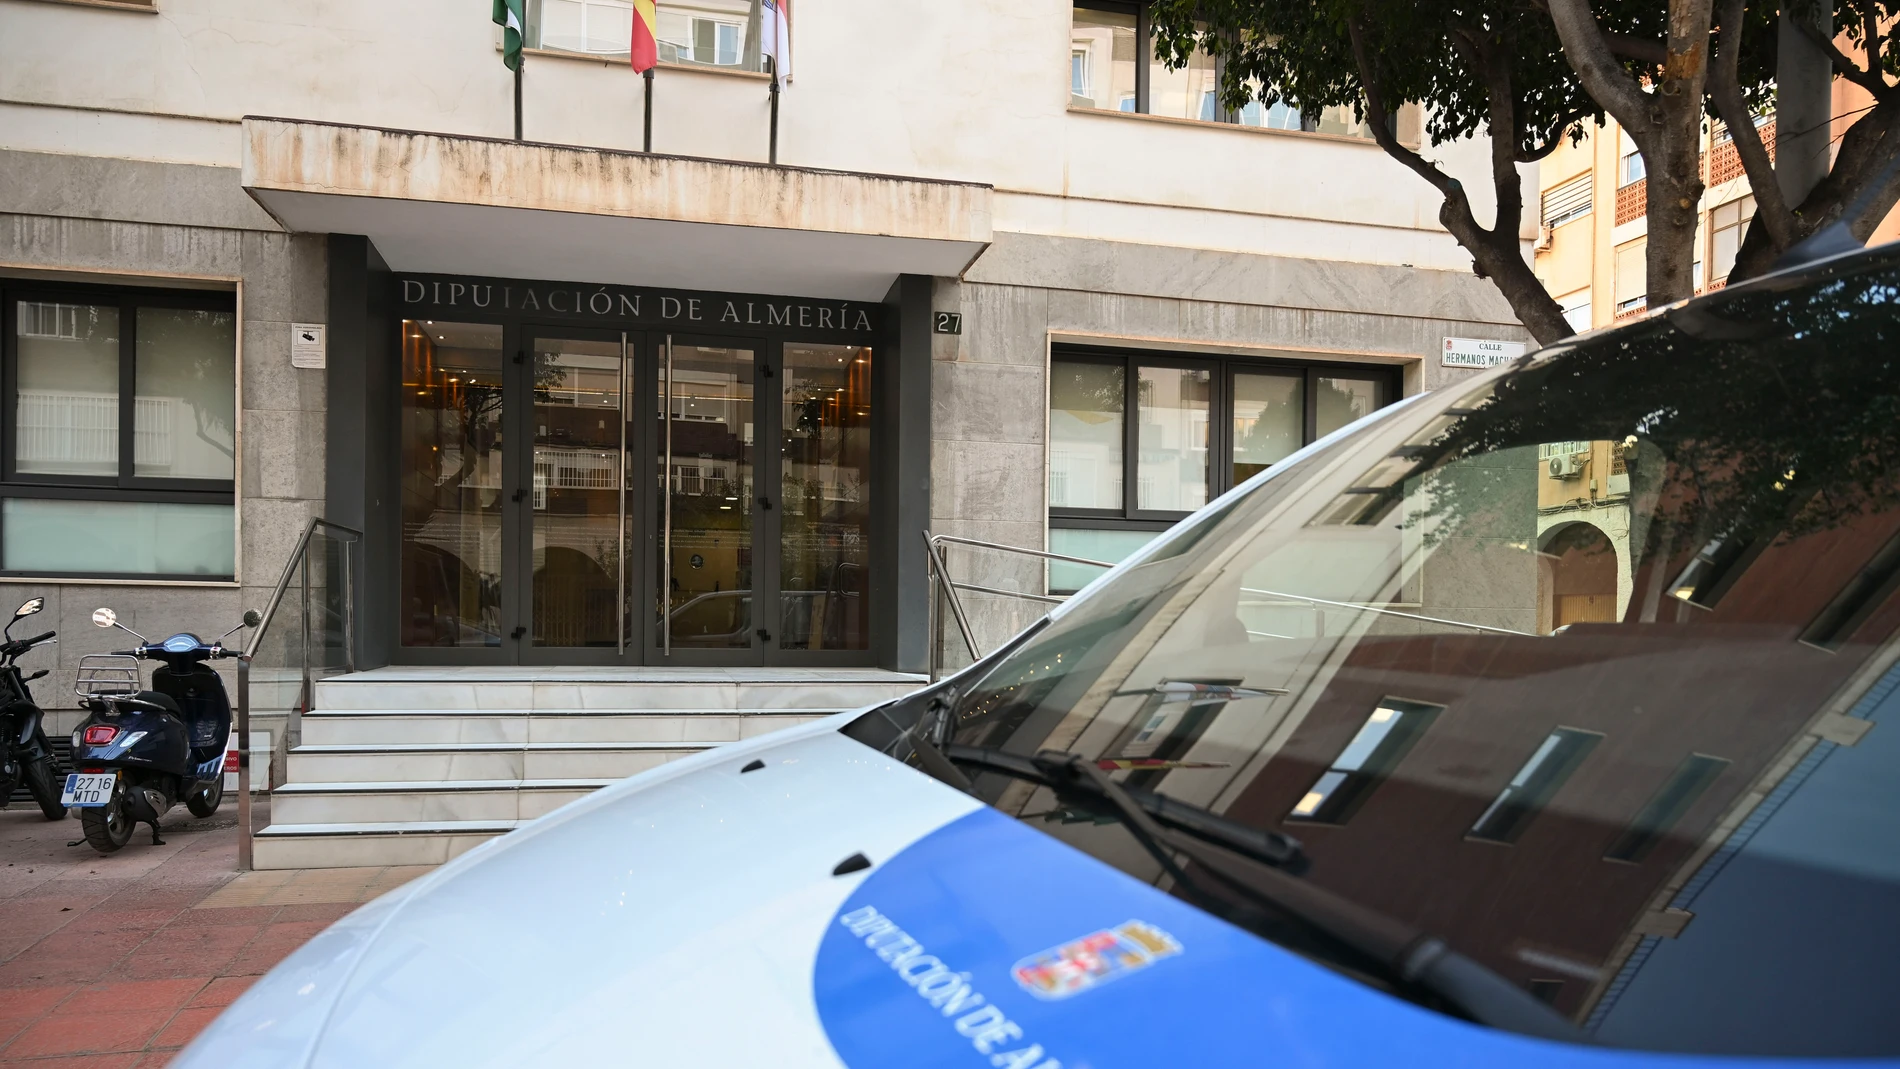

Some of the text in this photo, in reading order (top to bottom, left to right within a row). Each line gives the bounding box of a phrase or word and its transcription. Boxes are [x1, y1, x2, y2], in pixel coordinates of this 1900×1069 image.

[660, 297, 703, 321] DE
[719, 301, 873, 331] ALMERÍA
[938, 313, 960, 333] 27
[1479, 343, 1503, 351] CALLE
[1446, 353, 1486, 365] HERMANOS
[73, 790, 100, 803] MTD
[839, 904, 1064, 1069] DIPUTACIÓN DE A
